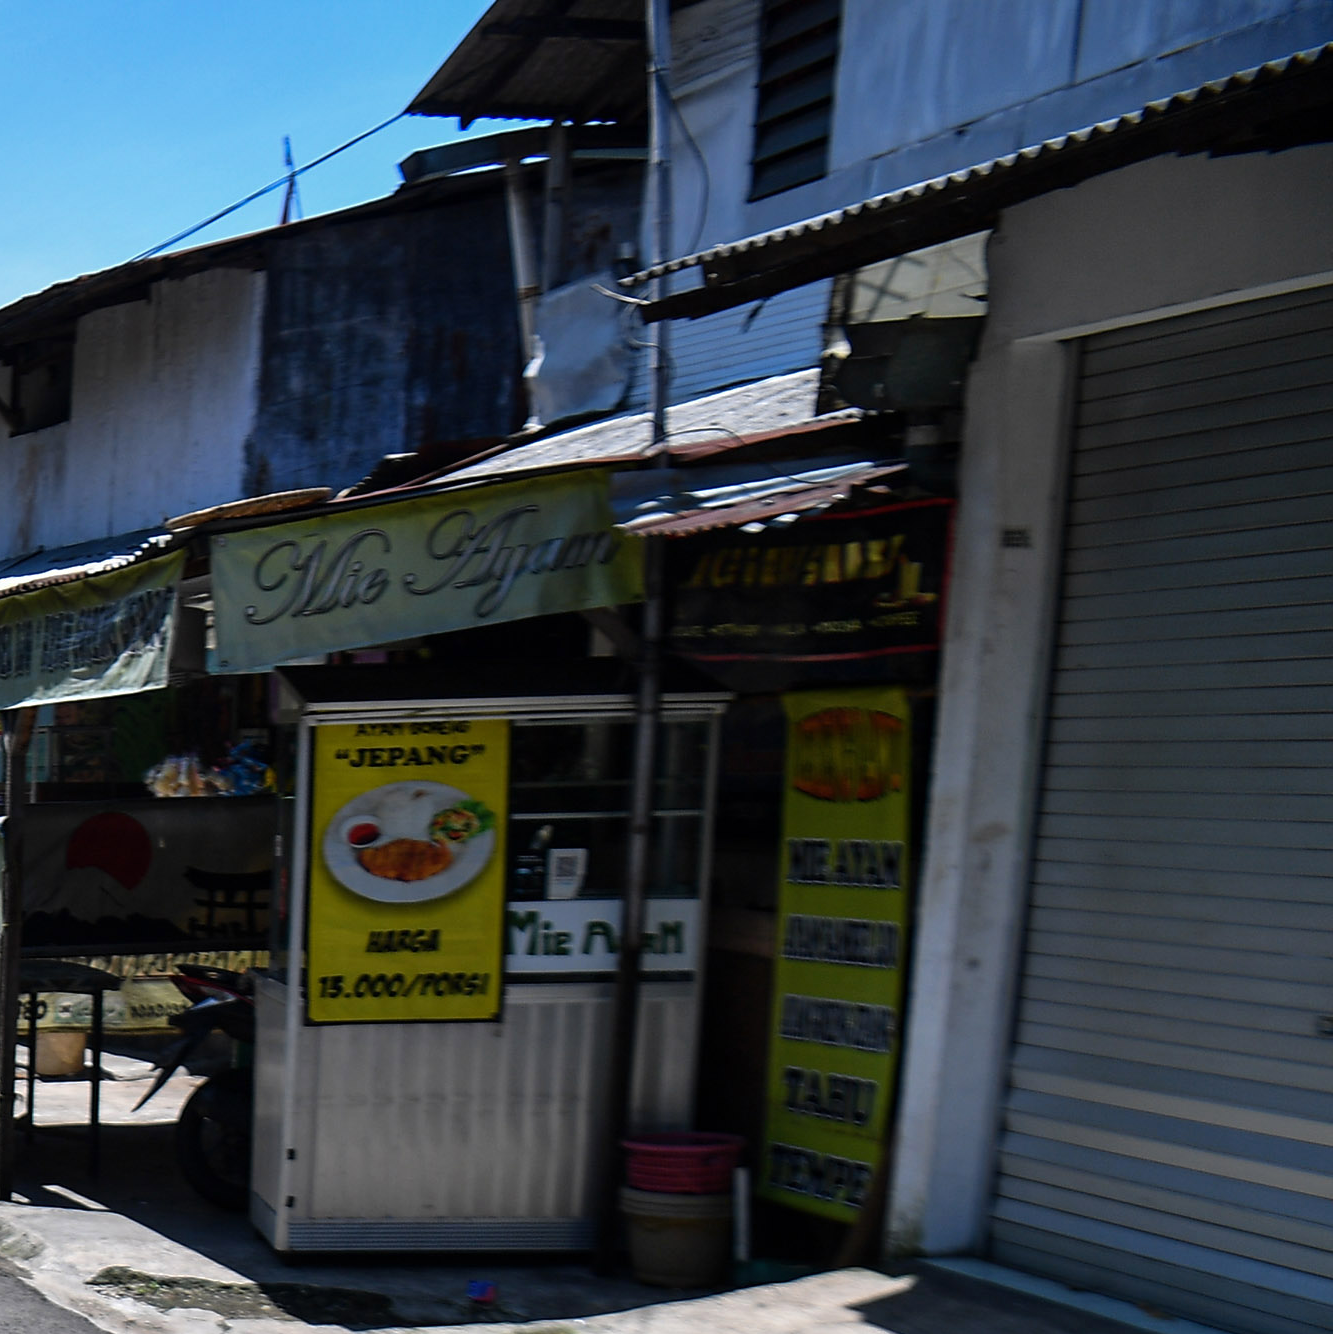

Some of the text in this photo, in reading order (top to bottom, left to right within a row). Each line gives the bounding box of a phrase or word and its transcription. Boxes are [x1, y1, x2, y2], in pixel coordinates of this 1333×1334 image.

[244, 527, 392, 626] Mie
[404, 504, 621, 618] Ayam
[365, 929, 442, 953] HARGA
[318, 972, 492, 999] 15.000/PORSI
